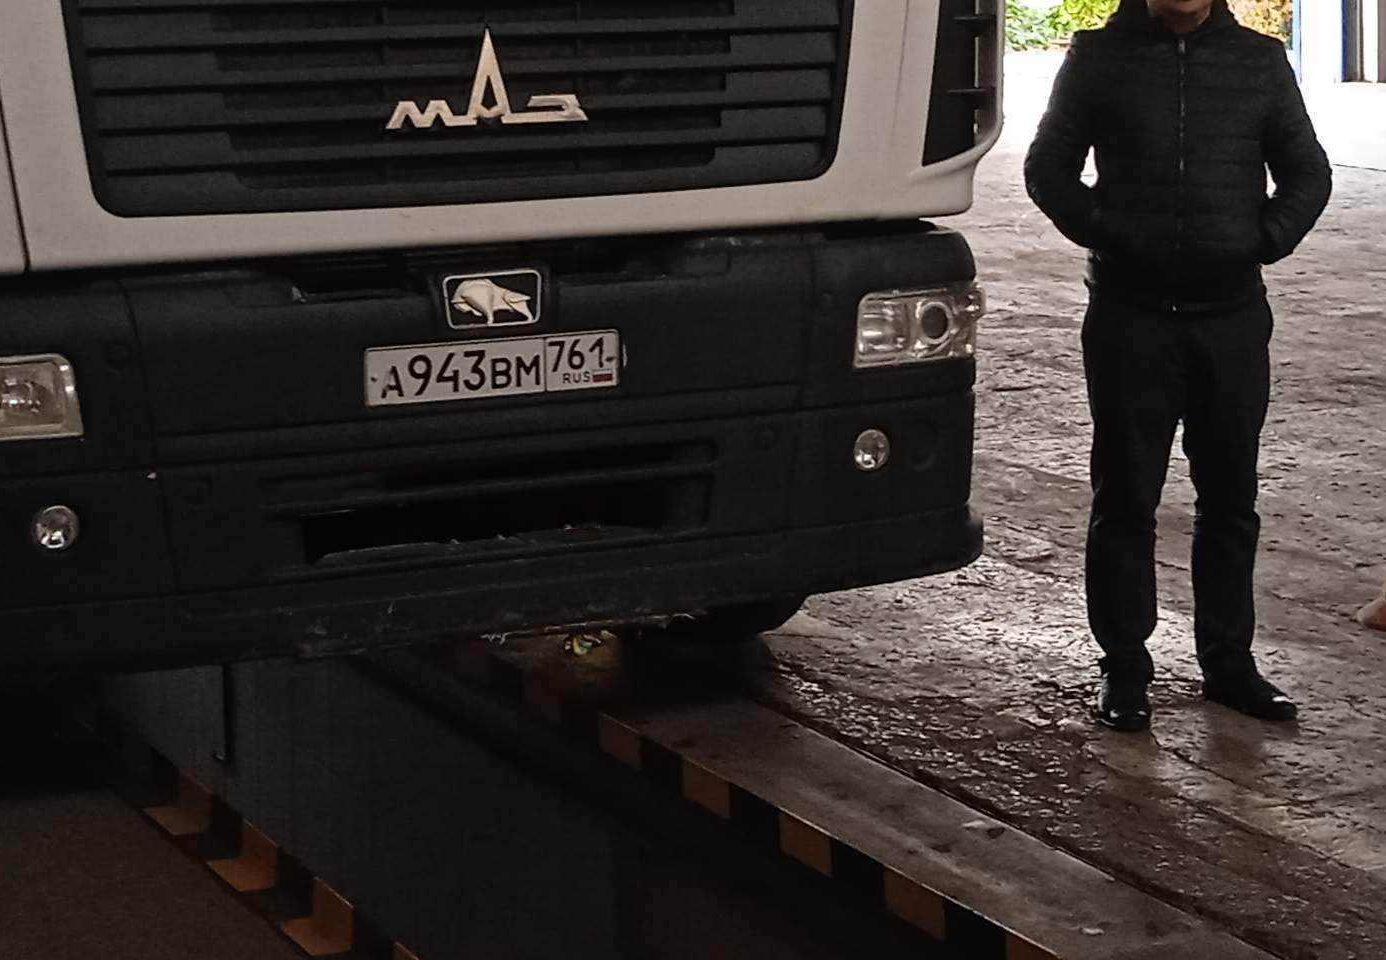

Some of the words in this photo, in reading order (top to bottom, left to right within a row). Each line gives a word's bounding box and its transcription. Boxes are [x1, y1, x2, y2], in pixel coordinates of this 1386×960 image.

[385, 27, 589, 130] МАЗ
[380, 349, 541, 399] А943ВМ
[548, 335, 605, 372] 761
[563, 370, 591, 385] RUS
